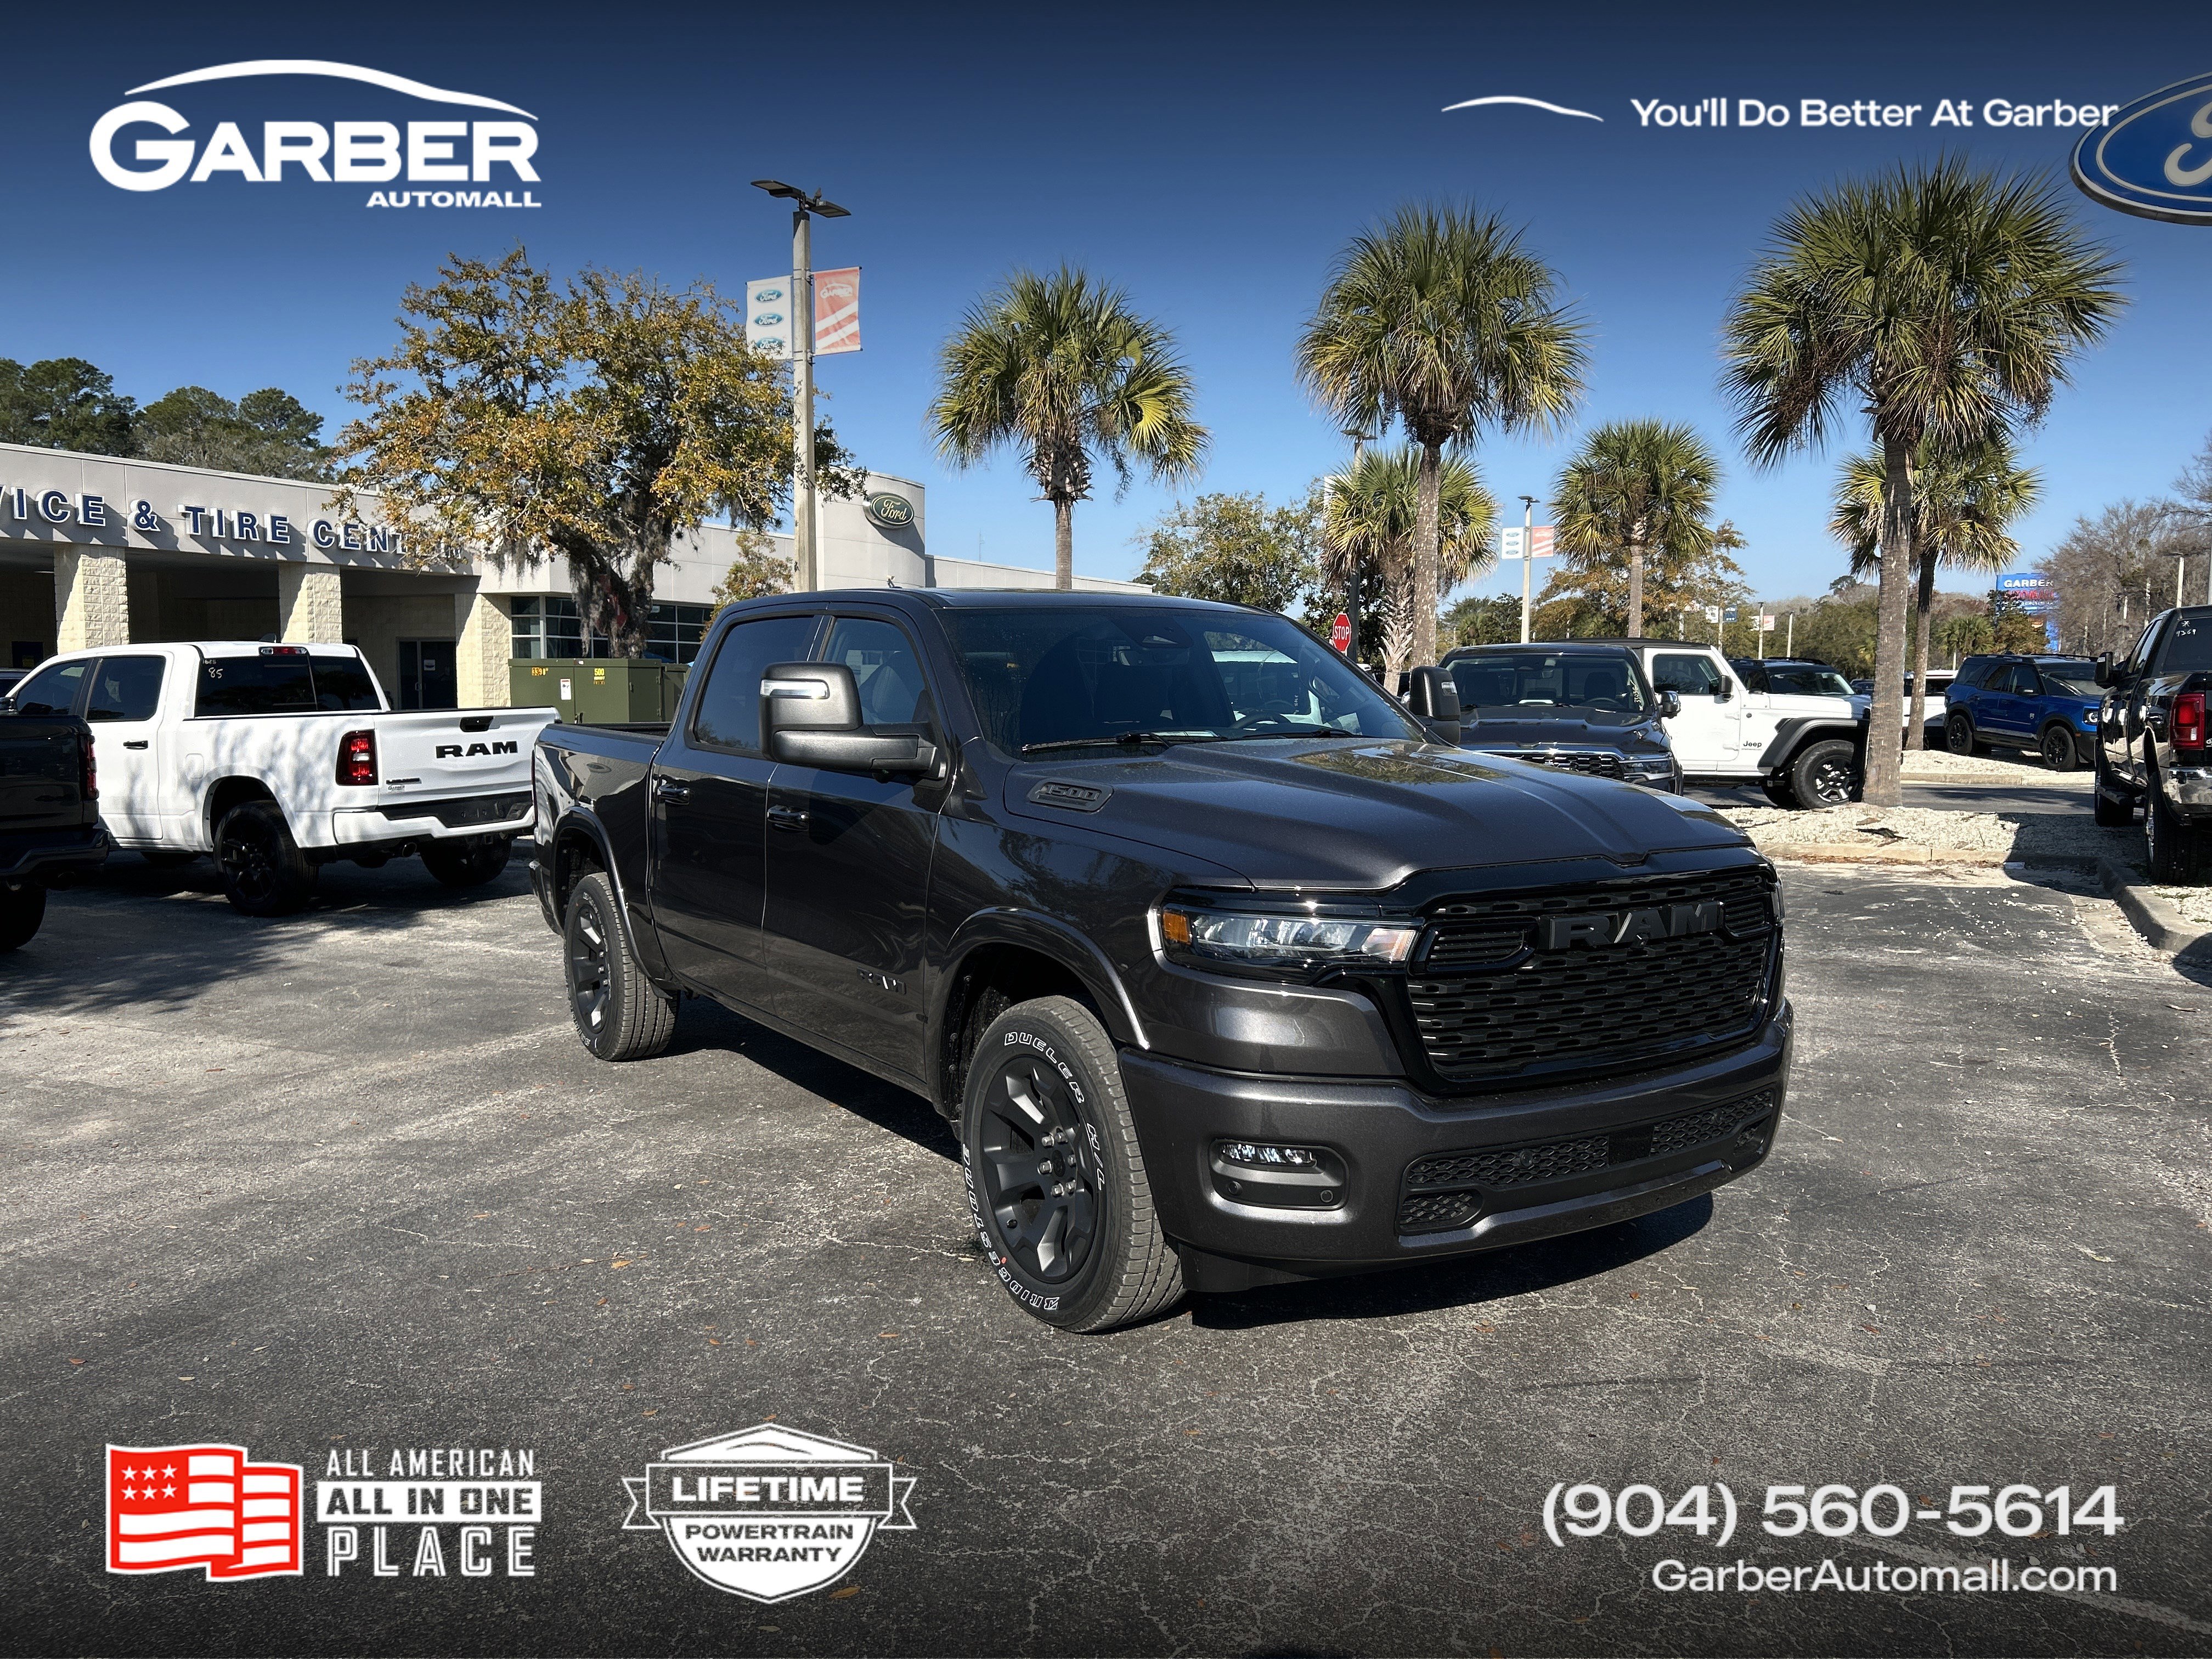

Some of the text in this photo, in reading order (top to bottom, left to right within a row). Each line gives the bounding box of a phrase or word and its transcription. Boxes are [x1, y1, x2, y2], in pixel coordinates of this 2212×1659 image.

[0, 485, 106, 527] ICE
[127, 499, 161, 532] &
[178, 504, 290, 545] TIRE
[881, 499, 907, 521] Ford
[1334, 625, 1350, 641] STOP
[208, 667, 223, 679] 85
[594, 668, 605, 676] 500
[436, 741, 518, 759] RAM
[1040, 783, 1101, 801] 1500
[1548, 900, 1722, 950] RAM
[1005, 1031, 1085, 1103] DUELER
[963, 1143, 1060, 1311] BRIDGESTONE
